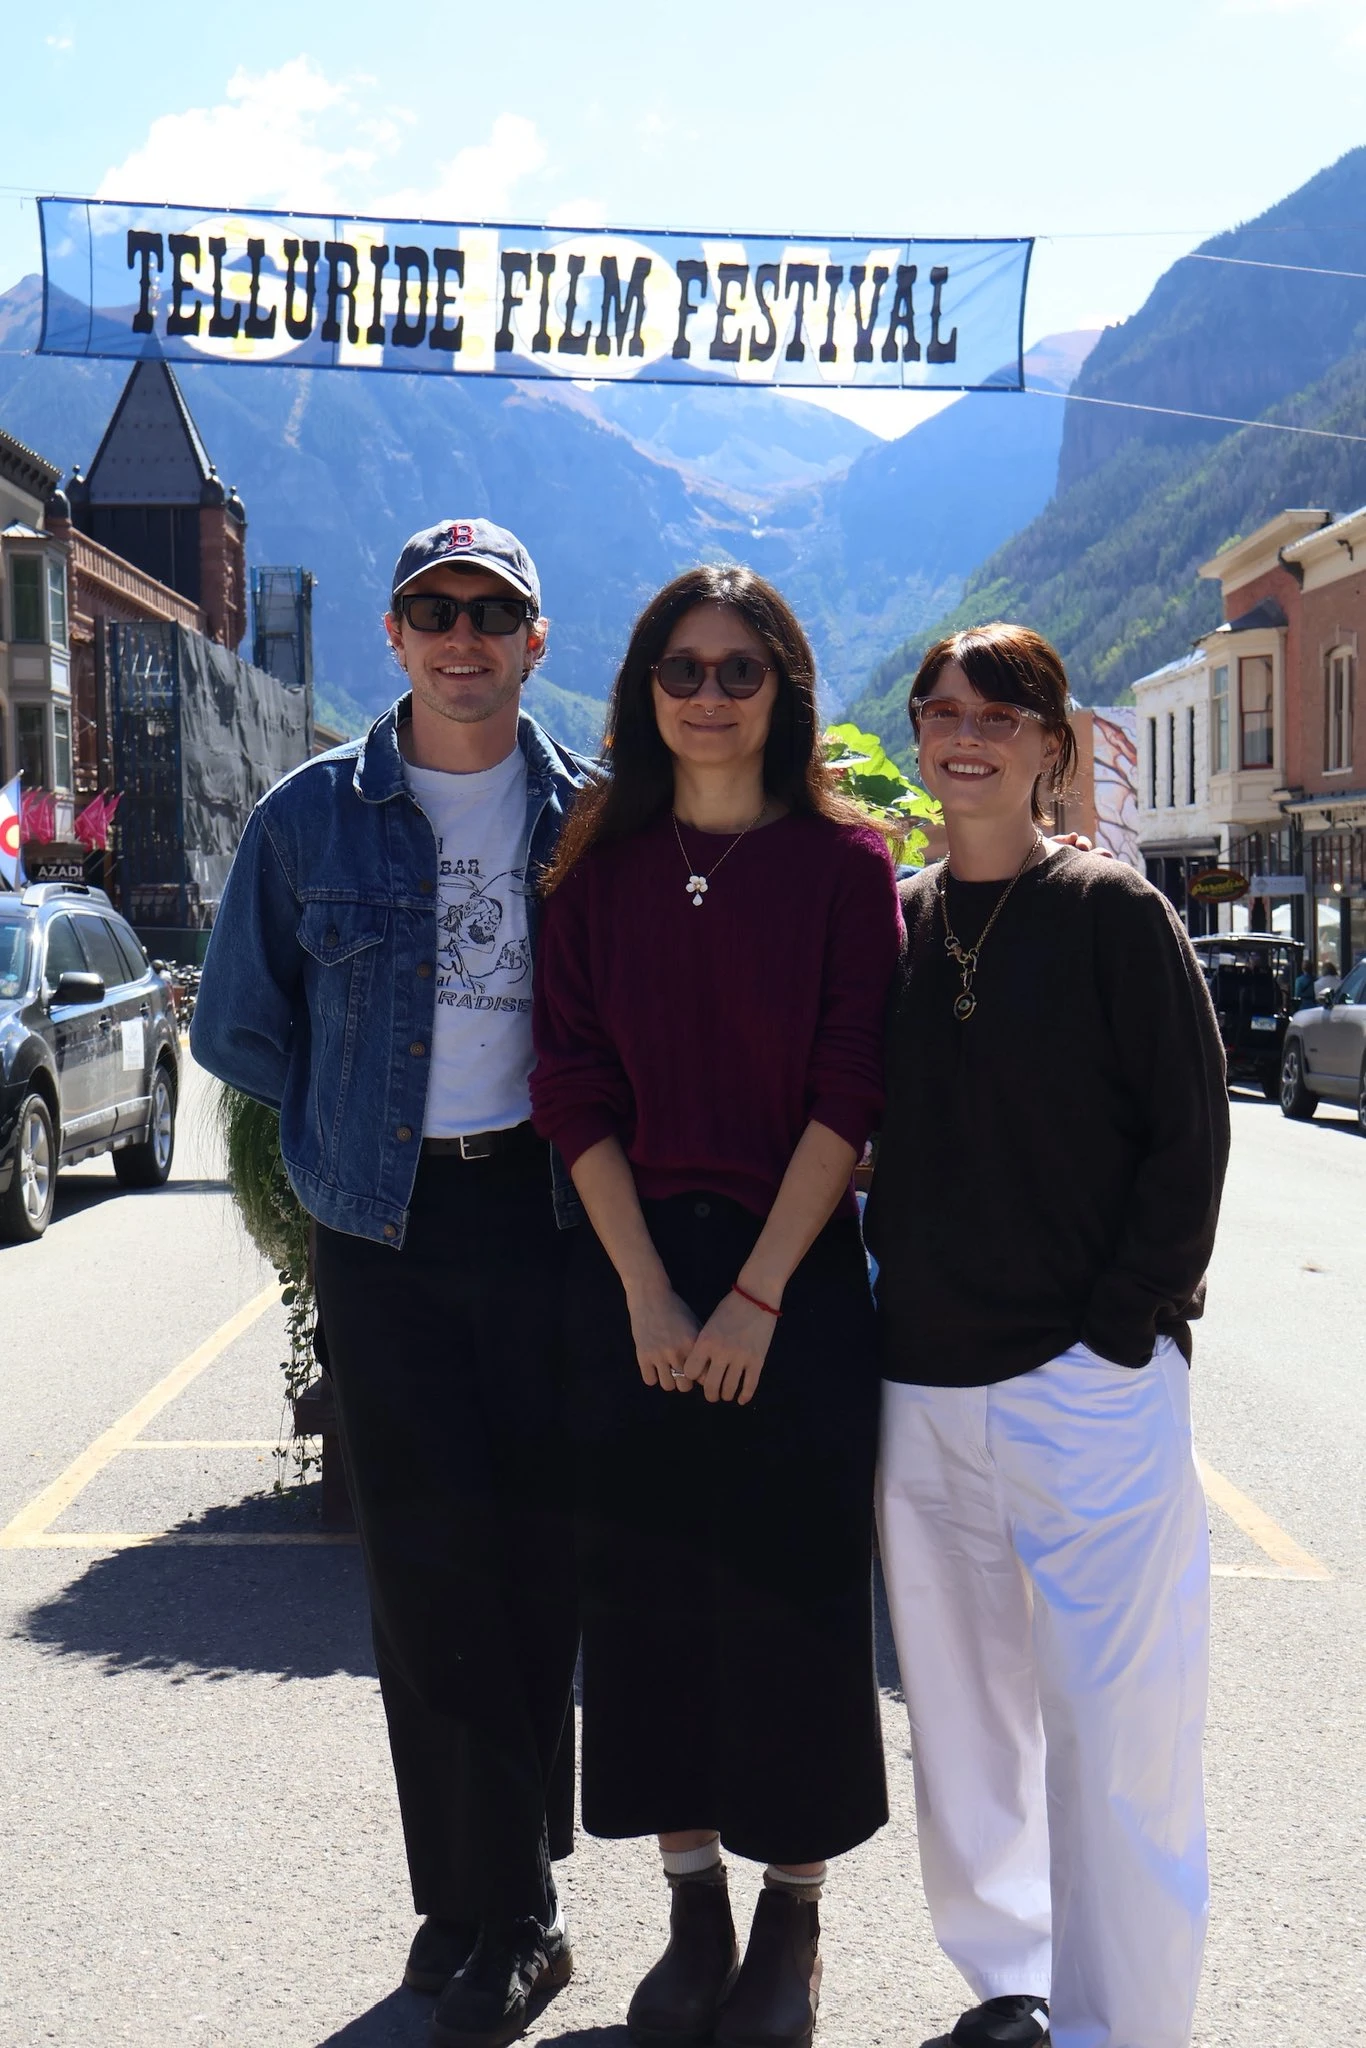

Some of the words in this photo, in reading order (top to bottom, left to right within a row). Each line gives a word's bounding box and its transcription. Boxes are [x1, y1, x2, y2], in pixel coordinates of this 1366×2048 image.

[127, 229, 466, 352] TELLURIDE
[495, 251, 652, 358] FILM
[672, 259, 957, 364] FESTIVAL
[446, 524, 475, 549] B
[38, 865, 83, 877] AZADI
[437, 990, 531, 1013] RADISE
